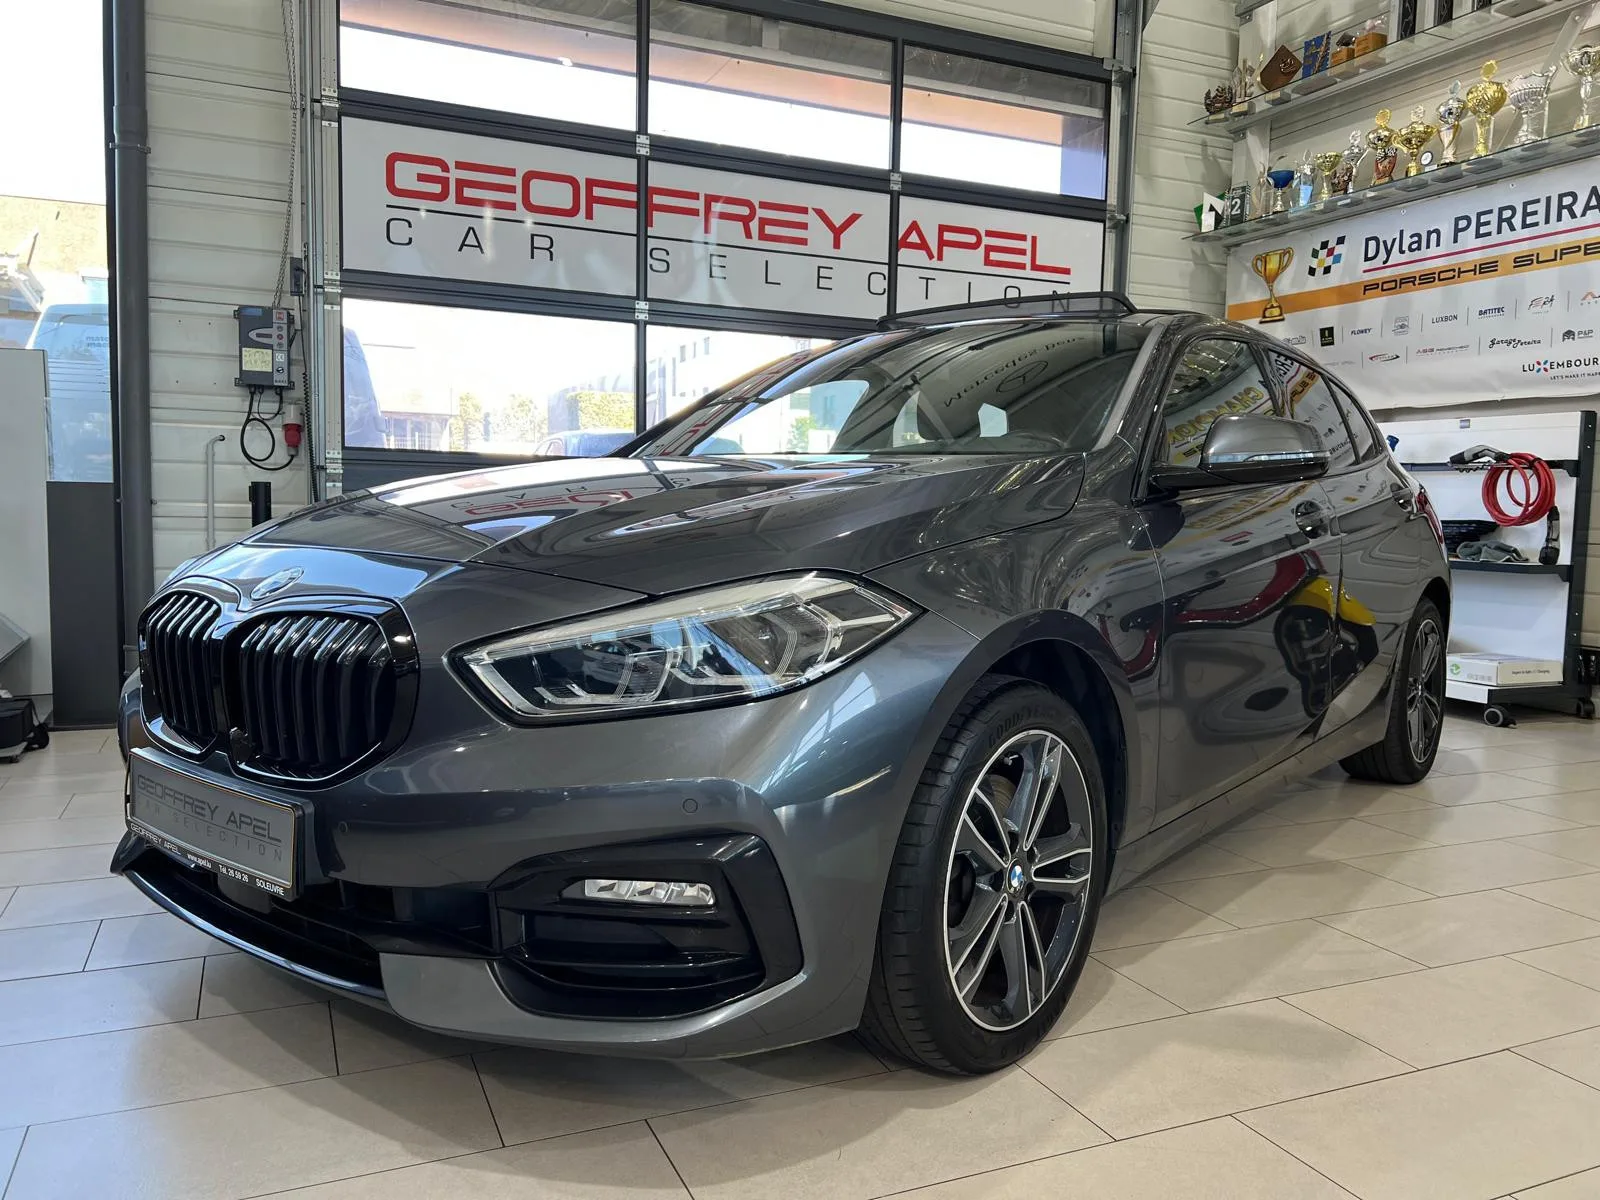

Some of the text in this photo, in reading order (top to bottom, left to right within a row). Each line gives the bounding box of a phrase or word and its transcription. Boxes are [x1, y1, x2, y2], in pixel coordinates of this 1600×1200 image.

[385, 151, 1072, 276] GEOFFREY APEL
[1363, 184, 1600, 265] Dylan PEREIRA
[386, 216, 1072, 313] CAR SELECTION
[1363, 261, 1499, 296] PORSCHE
[1431, 314, 1458, 325] LUXBON
[1488, 337, 1516, 349] Garage
[137, 774, 282, 843] GEOFFREY APEL
[130, 823, 162, 845] GEOFFREY
[164, 841, 182, 855] APEL
[187, 853, 212, 869] www.apel.lu
[256, 878, 285, 896] SOLEUVRE
